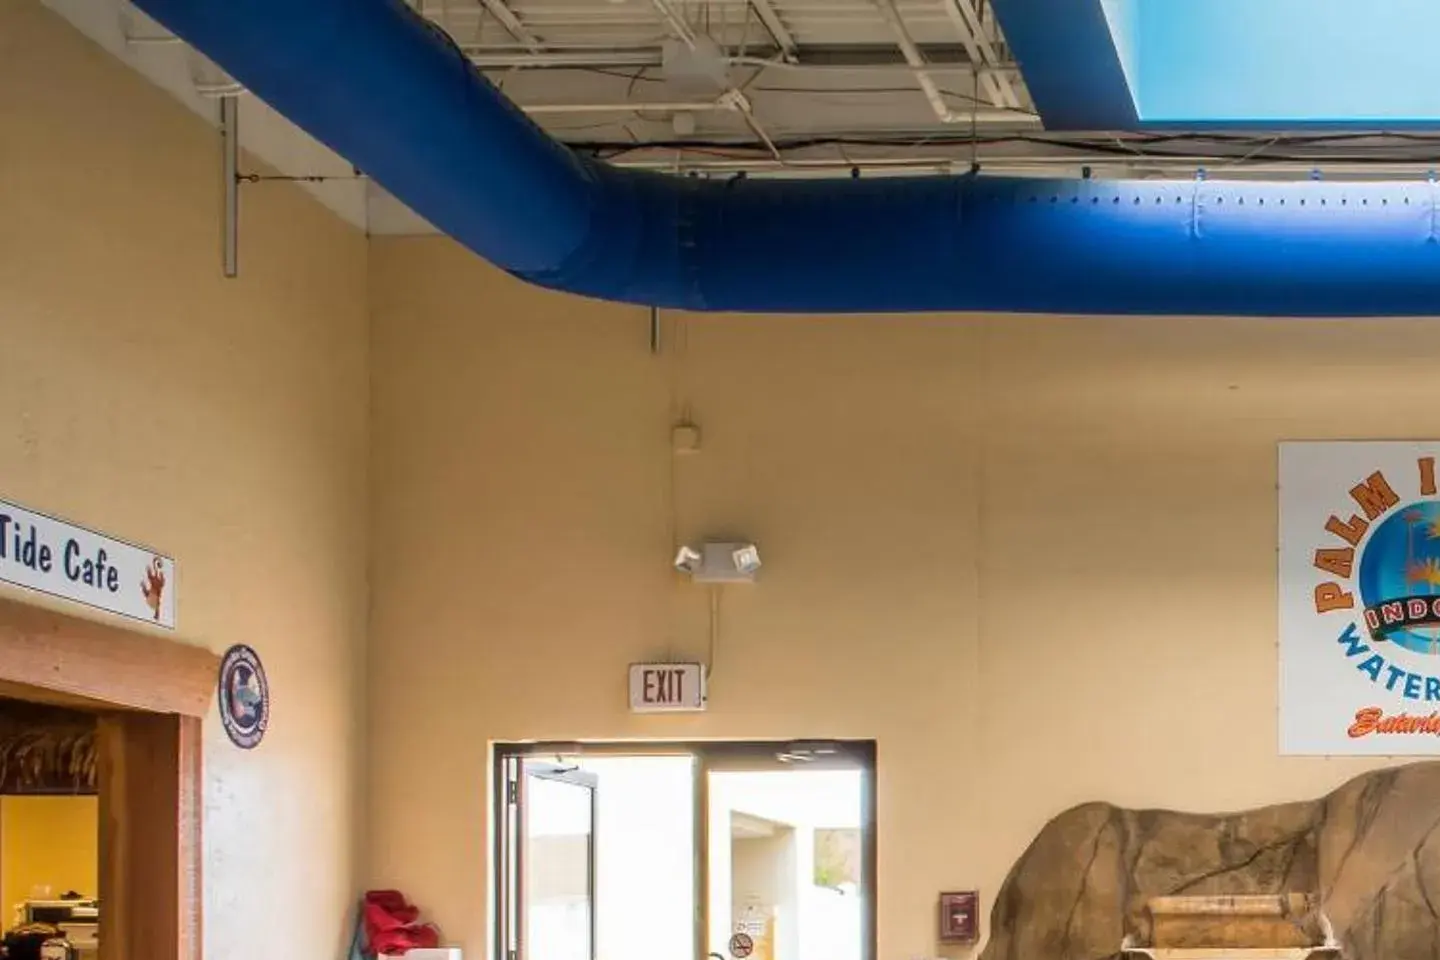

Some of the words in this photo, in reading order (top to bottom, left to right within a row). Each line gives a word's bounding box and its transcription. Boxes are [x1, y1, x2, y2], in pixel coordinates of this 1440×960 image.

[0, 514, 52, 573] Tide
[64, 538, 120, 593] Cafe
[1312, 470, 1400, 613] PALM
[643, 669, 686, 703] EXIT
